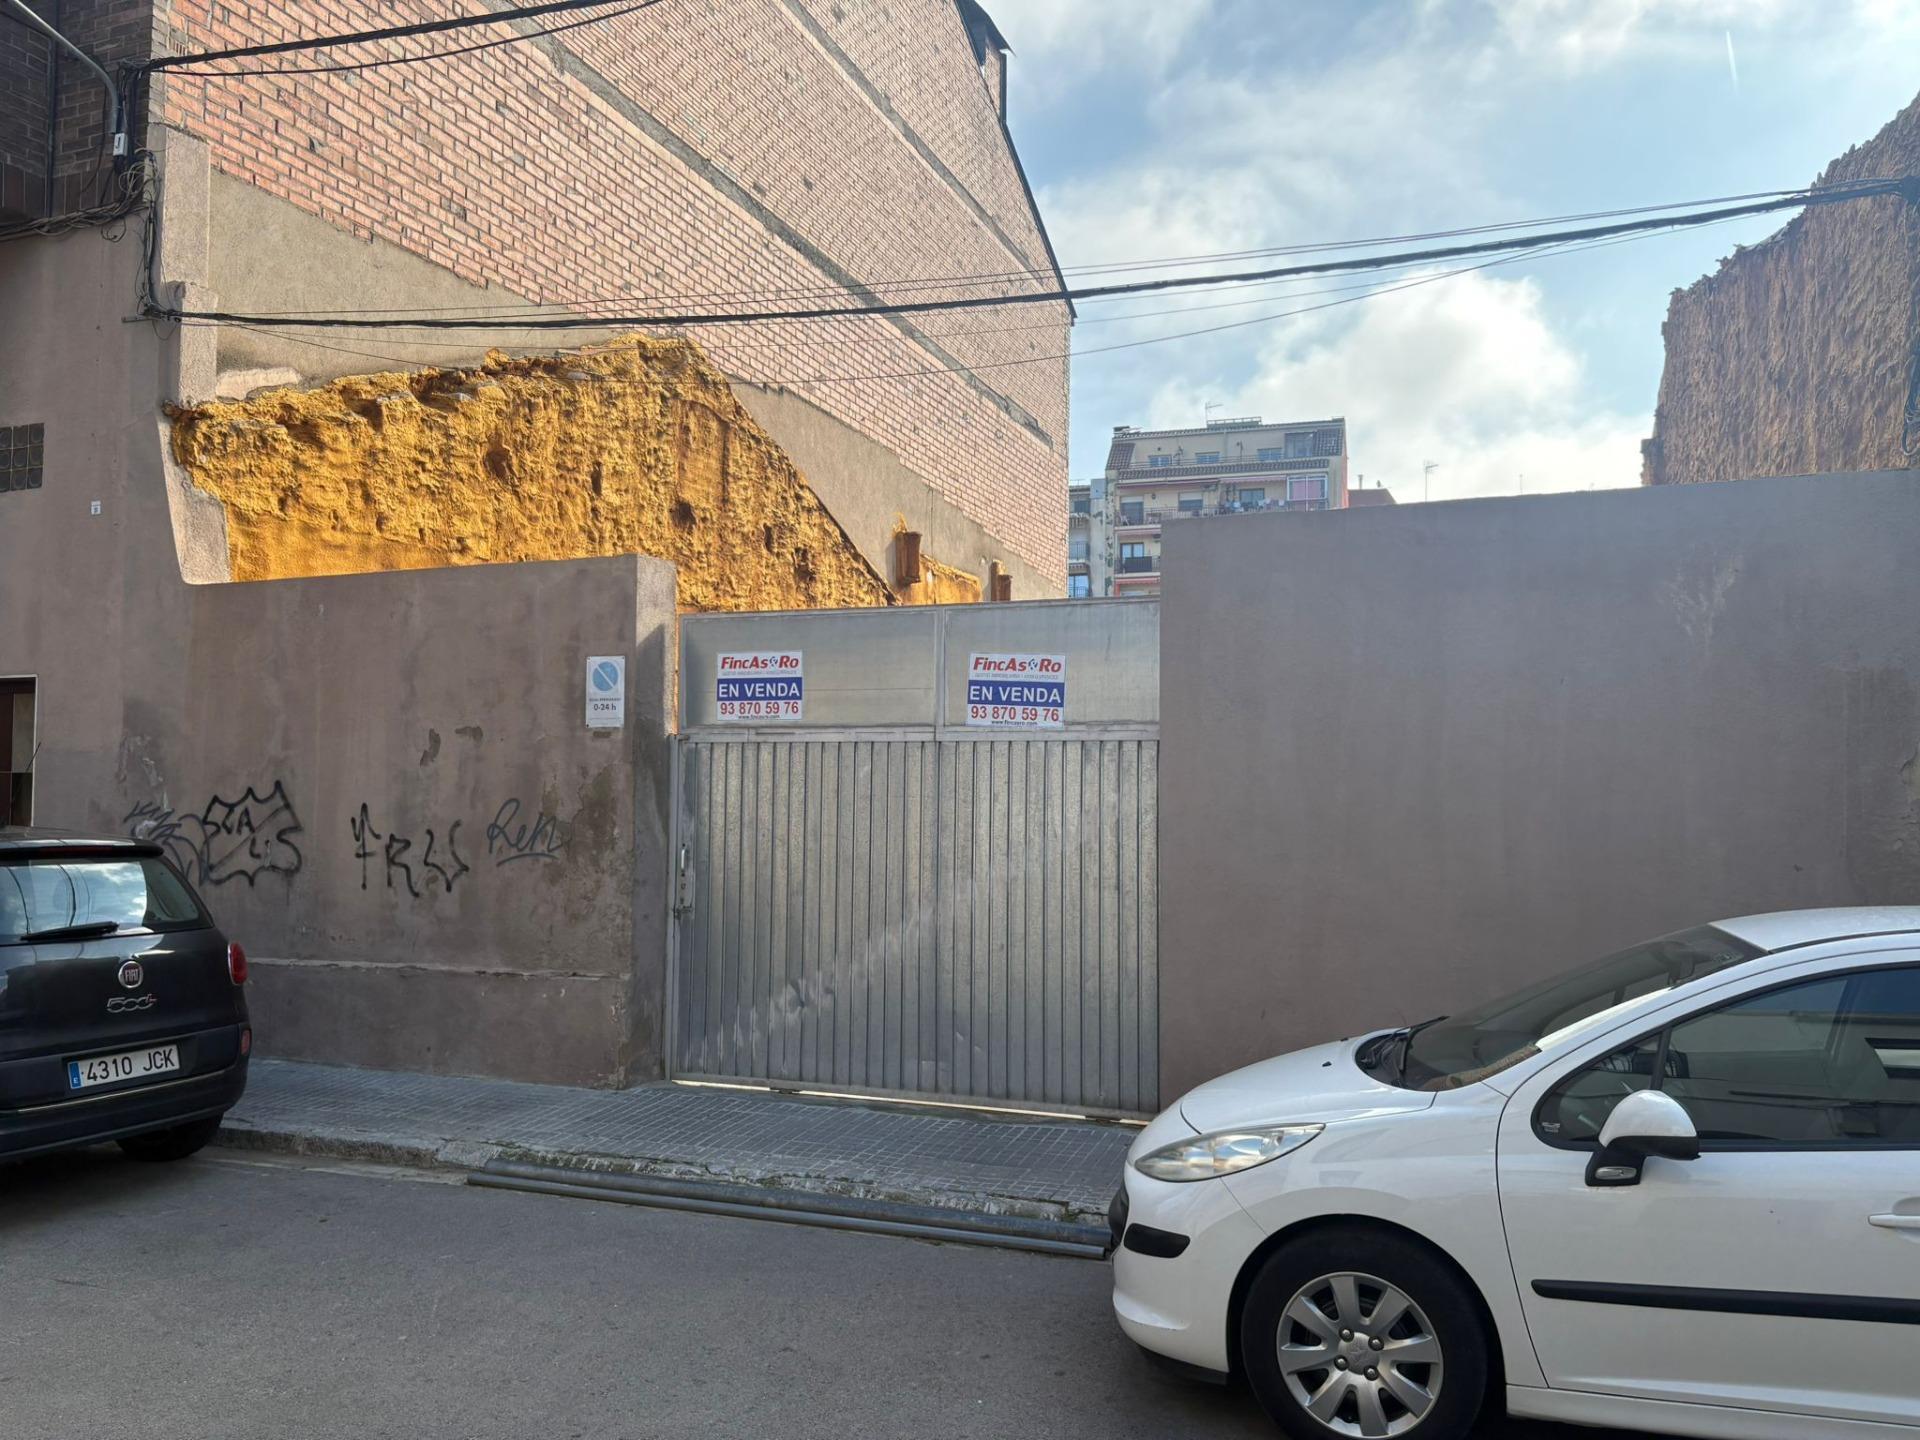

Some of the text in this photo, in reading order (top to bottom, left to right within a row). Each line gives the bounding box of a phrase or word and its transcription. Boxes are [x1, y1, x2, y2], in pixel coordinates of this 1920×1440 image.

[719, 682, 800, 698] EN VENDA
[970, 686, 1061, 703] EN VENDA
[611, 703, 617, 711] h
[720, 701, 799, 715] 93 870 59 76
[971, 705, 1060, 722] 93 870 59 76
[125, 969, 139, 982] FIAT
[87, 1056, 132, 1081] 4310
[143, 1048, 175, 1072] JCK
